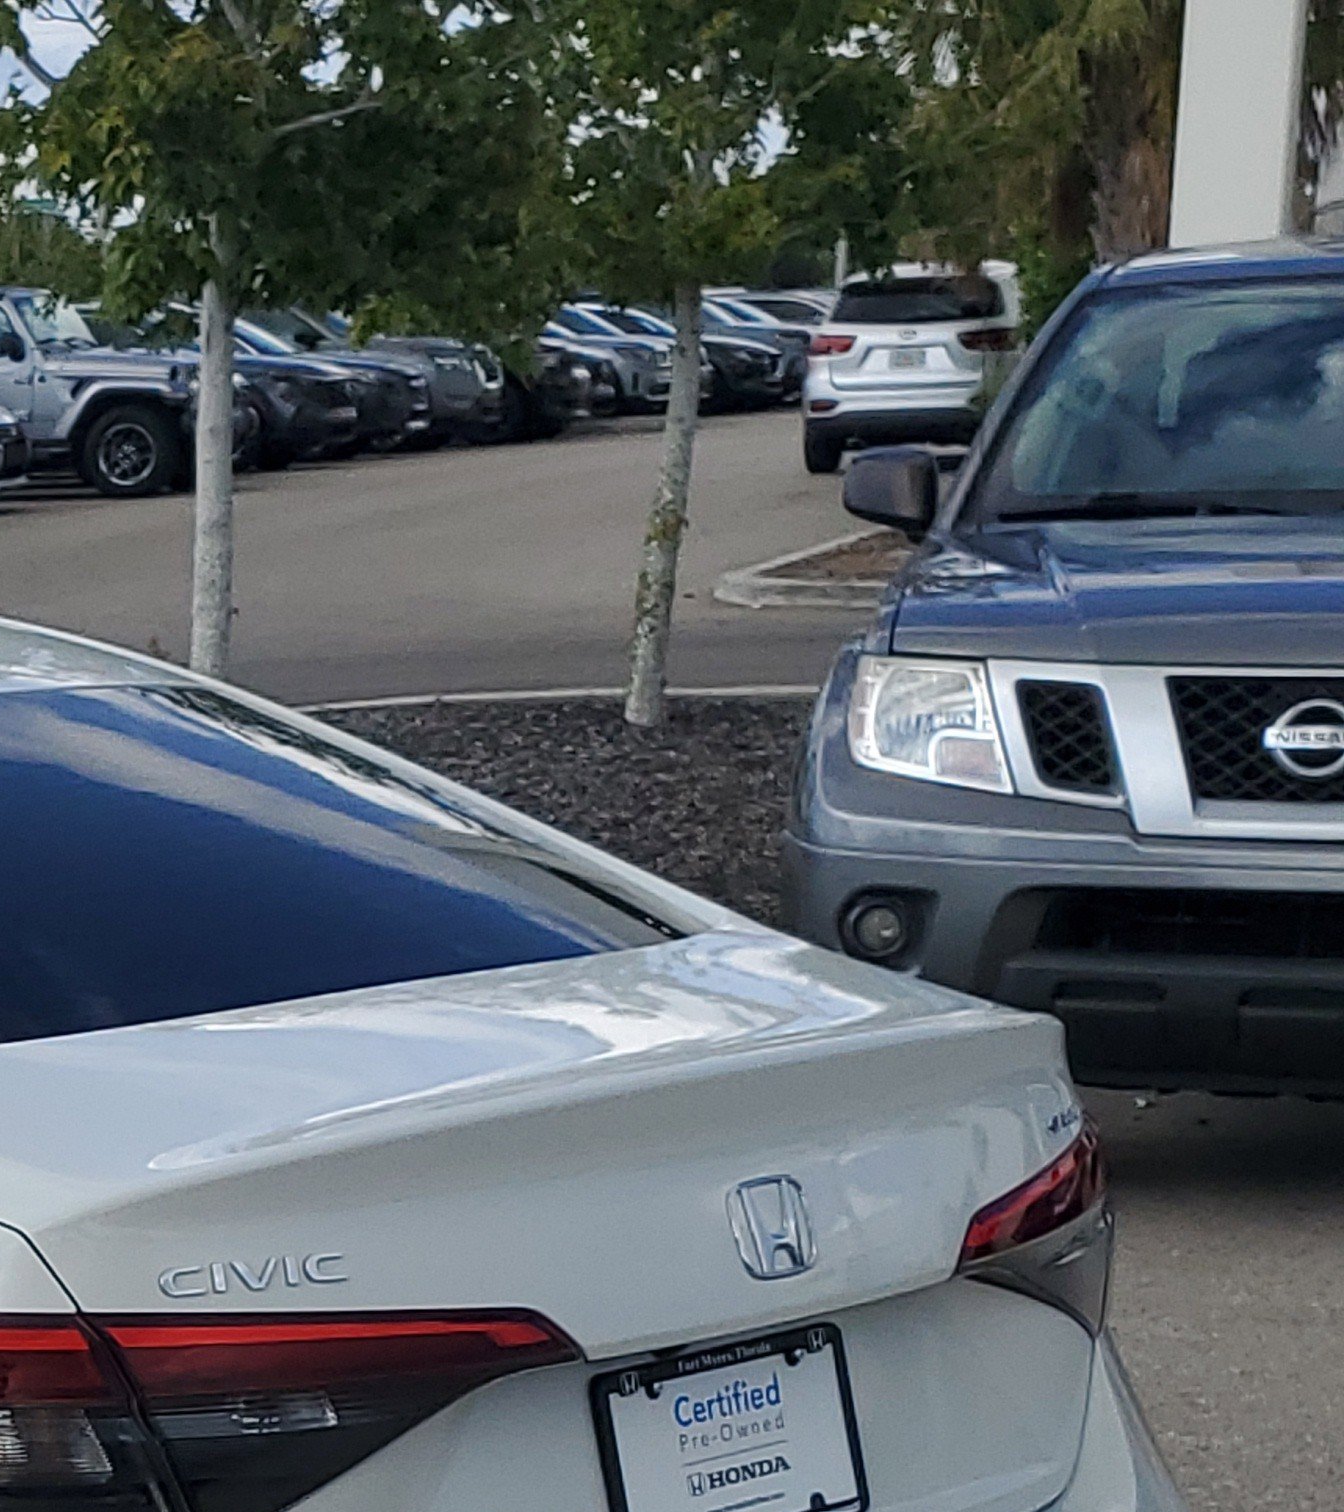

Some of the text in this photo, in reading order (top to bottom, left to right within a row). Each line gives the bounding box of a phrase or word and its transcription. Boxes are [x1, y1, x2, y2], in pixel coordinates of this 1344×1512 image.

[1275, 731, 1344, 744] NISSA
[158, 1252, 351, 1298] CIVIC
[674, 1371, 781, 1428] Certified
[678, 1410, 785, 1452] Pre-Owned
[709, 1456, 791, 1491] HONDA
